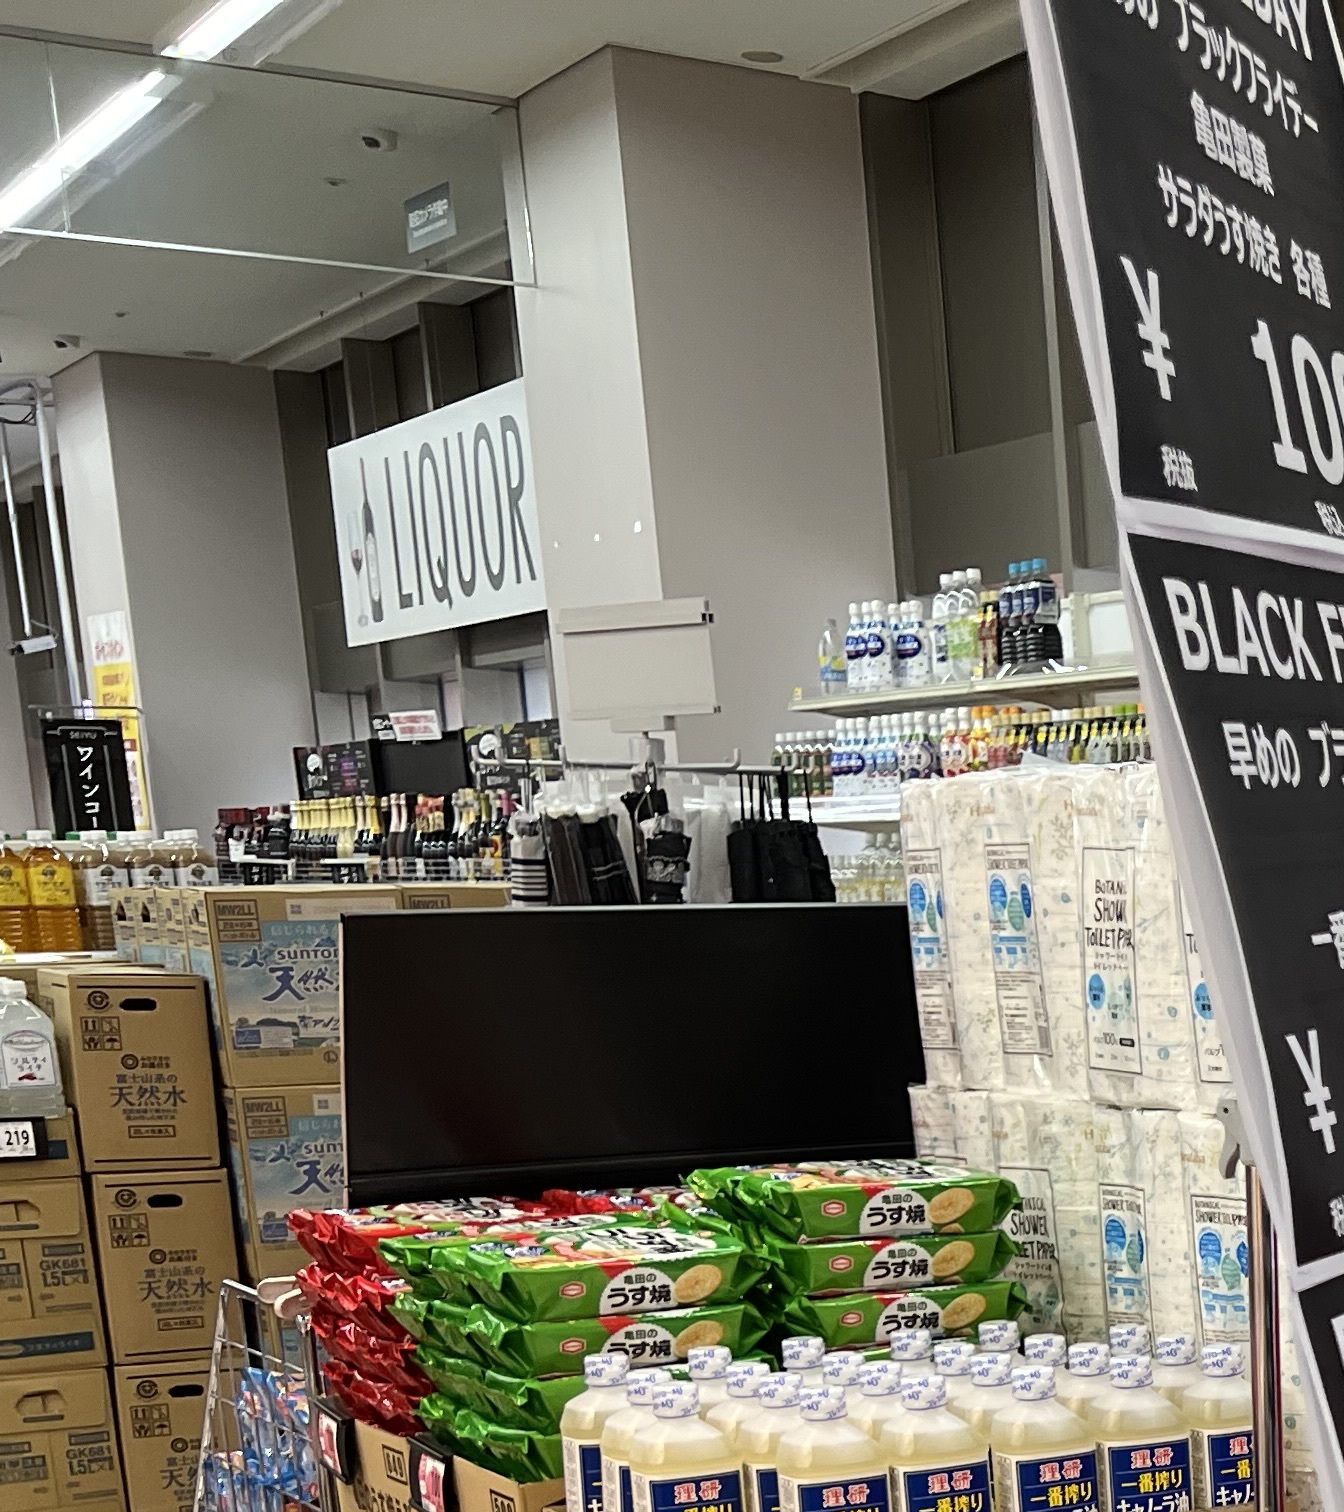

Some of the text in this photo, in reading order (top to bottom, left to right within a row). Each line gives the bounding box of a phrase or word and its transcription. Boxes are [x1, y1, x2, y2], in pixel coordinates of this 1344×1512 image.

[1190, 89, 1274, 197] 亀田製菓
[1156, 161, 1332, 310] サラダうす焼き 各種
[1119, 255, 1177, 402] ¥
[1160, 445, 1198, 492] 税抜
[382, 410, 538, 611] LIQUOR
[1162, 576, 1325, 684] BLACK
[1220, 719, 1301, 790] 早めの
[109, 1085, 188, 1109] 天然水
[1285, 1027, 1338, 1155] ¥
[4, 1129, 30, 1147] 219
[866, 1203, 926, 1228] うす焼
[871, 1258, 929, 1280] うす焼
[138, 1279, 215, 1301] 天然水
[606, 1285, 672, 1310] うす焼
[882, 1312, 940, 1333] うす焼
[1130, 1446, 1174, 1469] 理研
[927, 1470, 974, 1495] 理研
[1039, 1458, 1084, 1483] 理研
[1120, 1468, 1184, 1494] 一番搾り
[673, 1479, 722, 1505] 理研
[822, 1483, 870, 1508] 理研
[1029, 1481, 1093, 1508] 一番搾り
